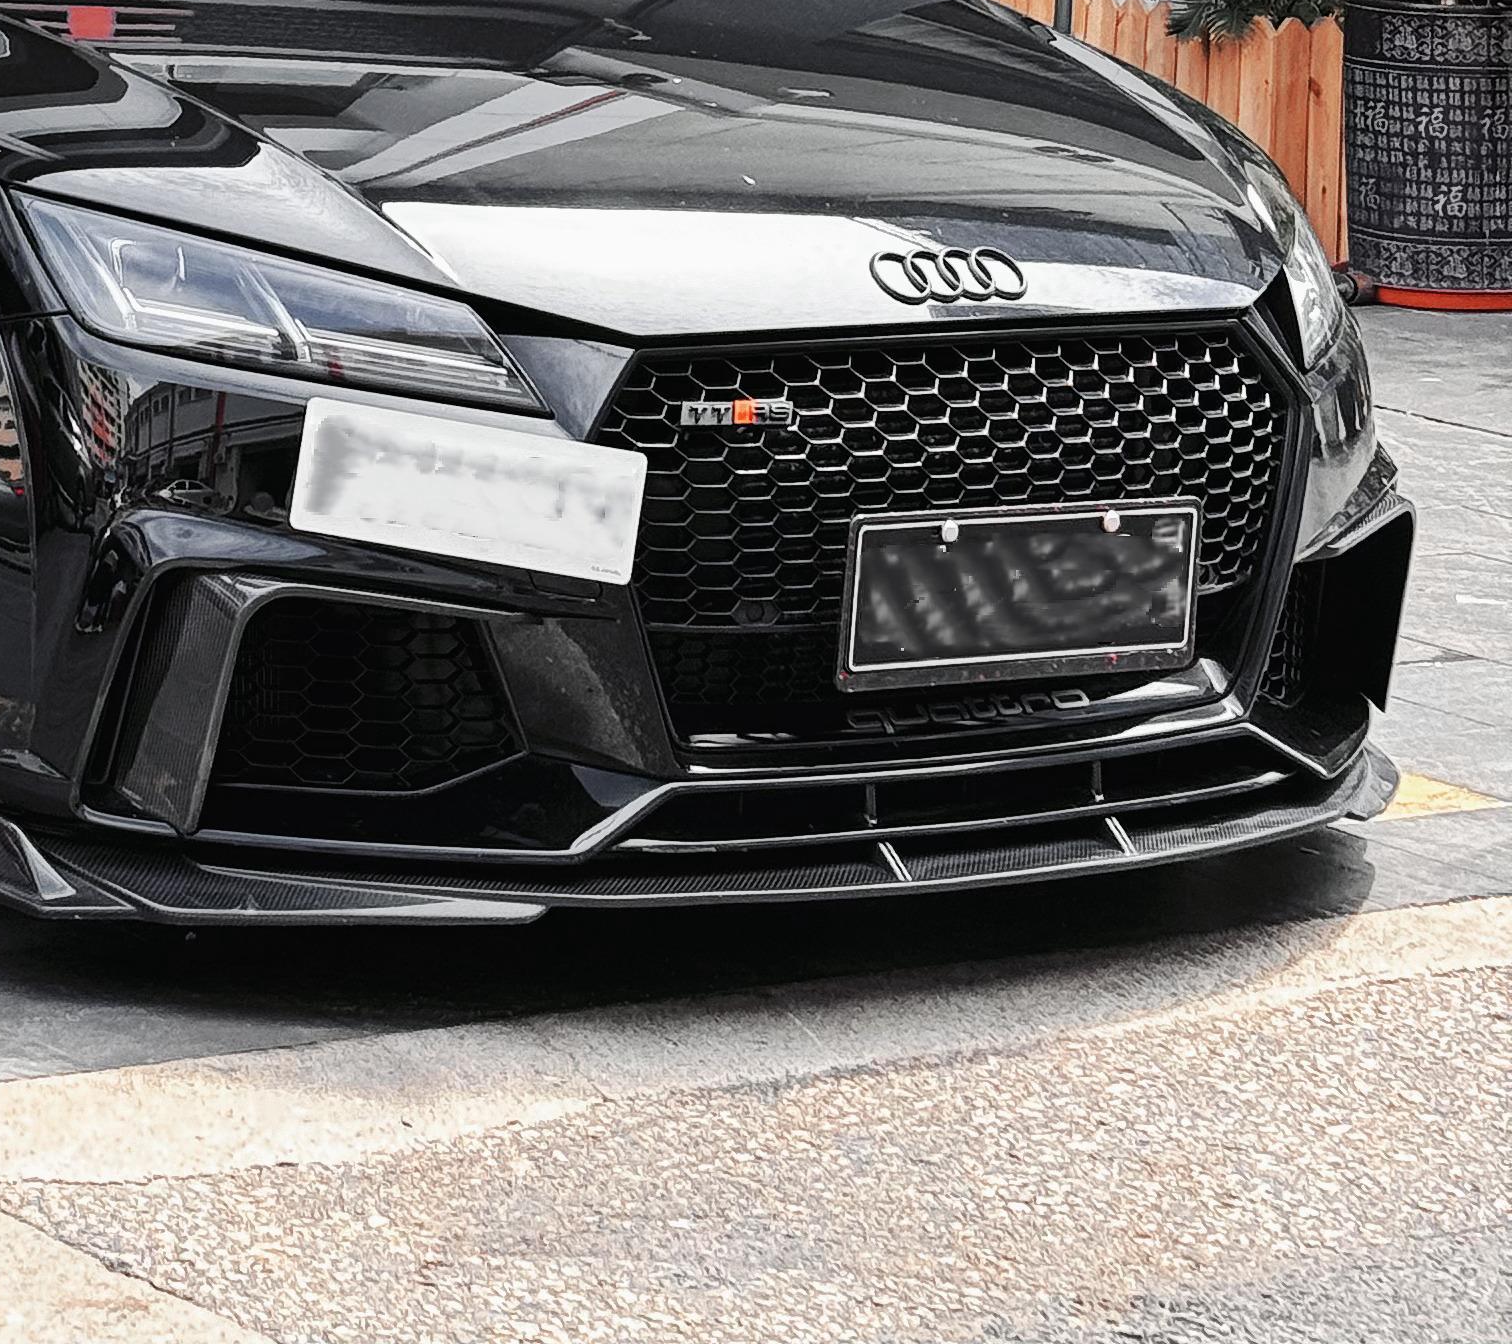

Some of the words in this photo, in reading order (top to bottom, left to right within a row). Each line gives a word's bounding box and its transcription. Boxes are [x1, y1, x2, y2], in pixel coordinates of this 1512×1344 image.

[1416, 106, 1449, 139] 福
[1481, 108, 1510, 140] 福
[1434, 185, 1468, 218] 福
[846, 688, 1090, 735] quattro
